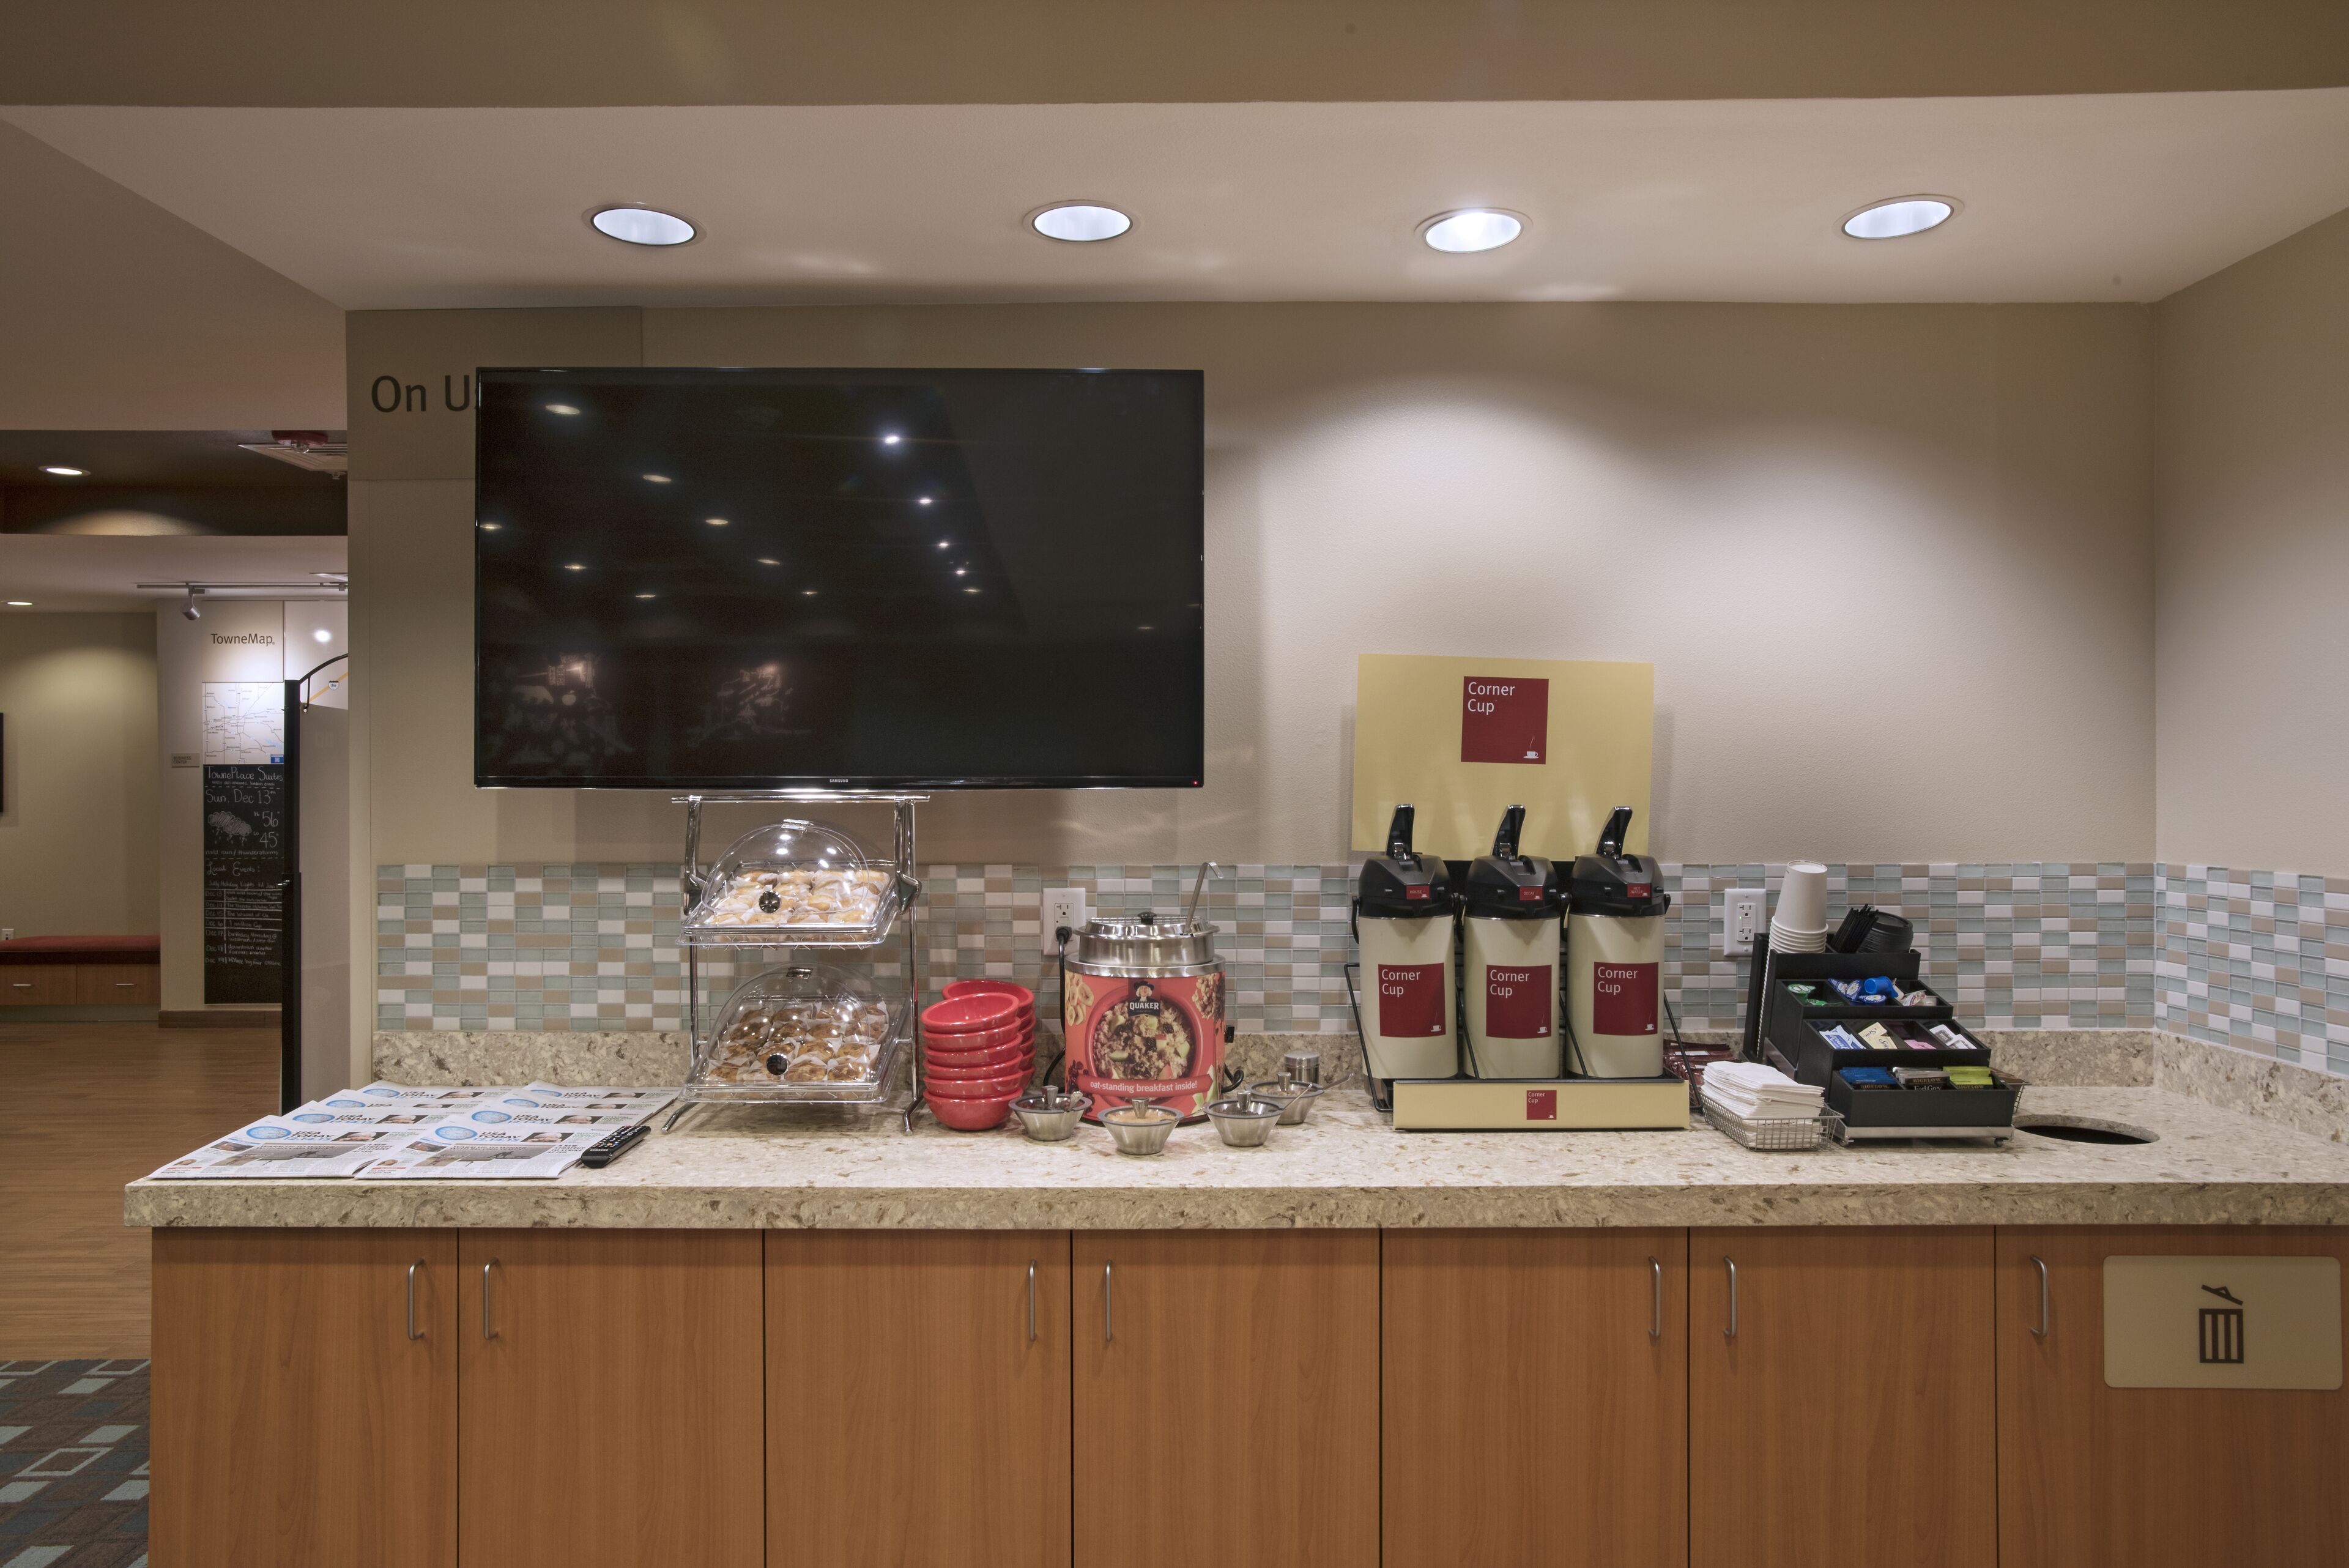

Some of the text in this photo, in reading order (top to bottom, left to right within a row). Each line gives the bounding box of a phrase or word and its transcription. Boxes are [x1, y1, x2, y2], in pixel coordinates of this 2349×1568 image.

[371, 375, 477, 412] On U
[1468, 682, 1515, 696] Corner
[1467, 699, 1495, 715] Cup
[204, 766, 283, 781] TownePlace Suites
[234, 789, 254, 804] Dec
[1381, 968, 1420, 981] Corner
[1490, 970, 1530, 983] Corner
[1598, 967, 1638, 979] Corner
[1381, 983, 1405, 997] Cup
[1490, 984, 1513, 998] Cup
[1597, 981, 1621, 995] Cup
[1129, 1002, 1159, 1011] QUAKER
[1090, 1082, 1198, 1093] oat-standing breakfast inside!
